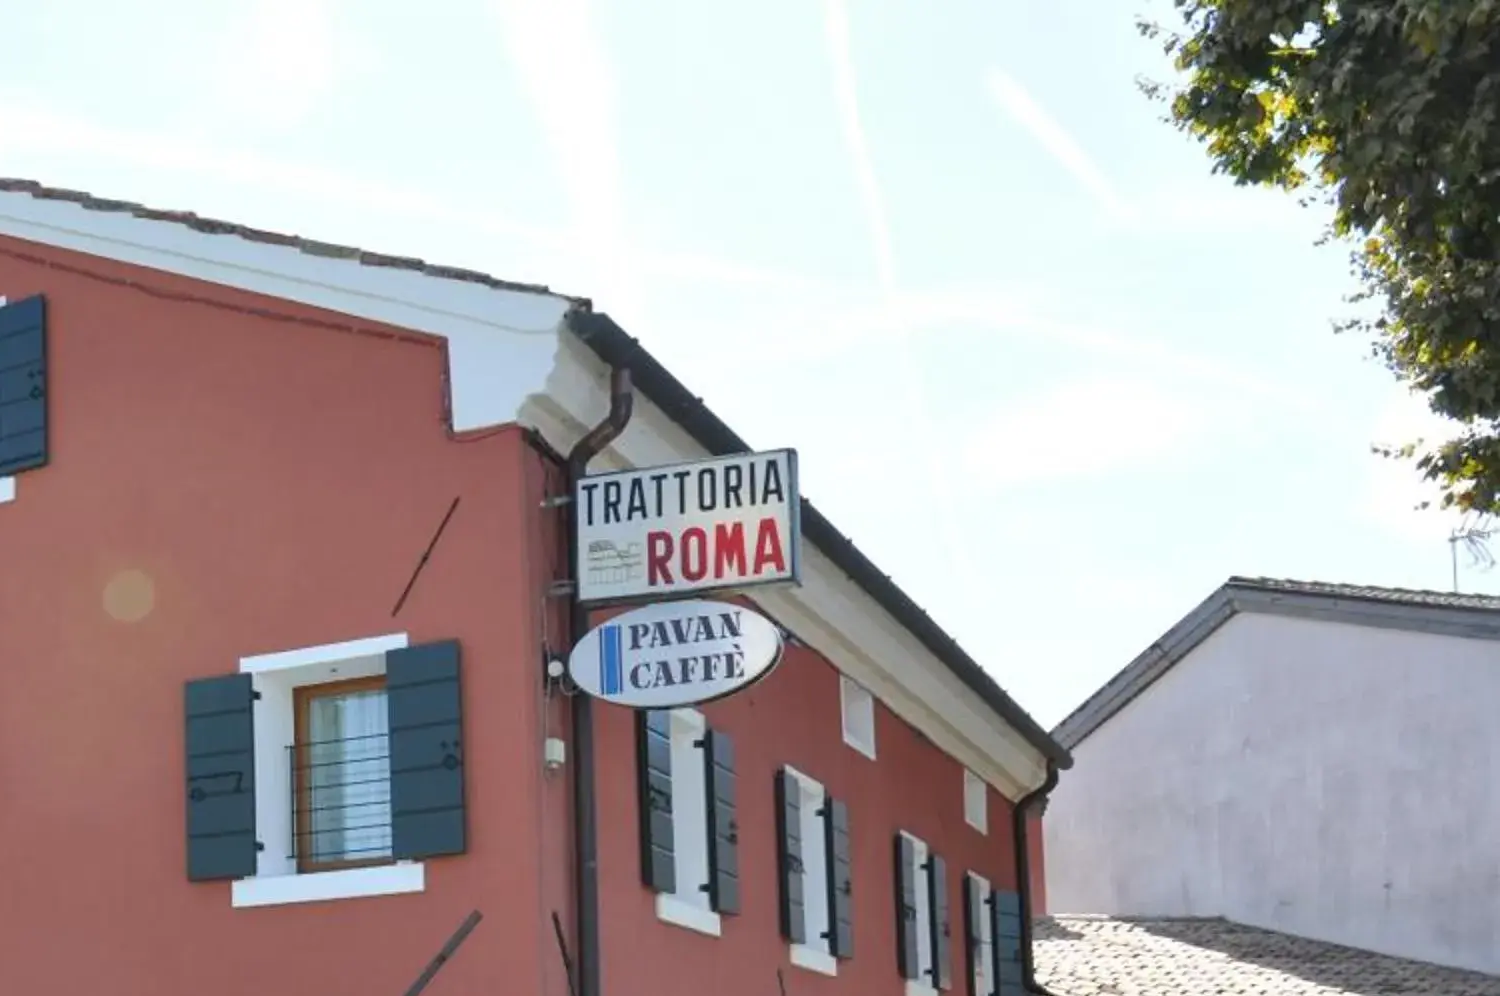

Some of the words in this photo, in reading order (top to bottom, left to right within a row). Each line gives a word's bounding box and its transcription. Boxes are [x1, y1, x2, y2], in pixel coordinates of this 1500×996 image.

[581, 459, 785, 526] TRATTORIA
[647, 517, 786, 586] ROMA
[629, 611, 743, 650] PAVAN
[629, 643, 746, 690] CAFFÈ
